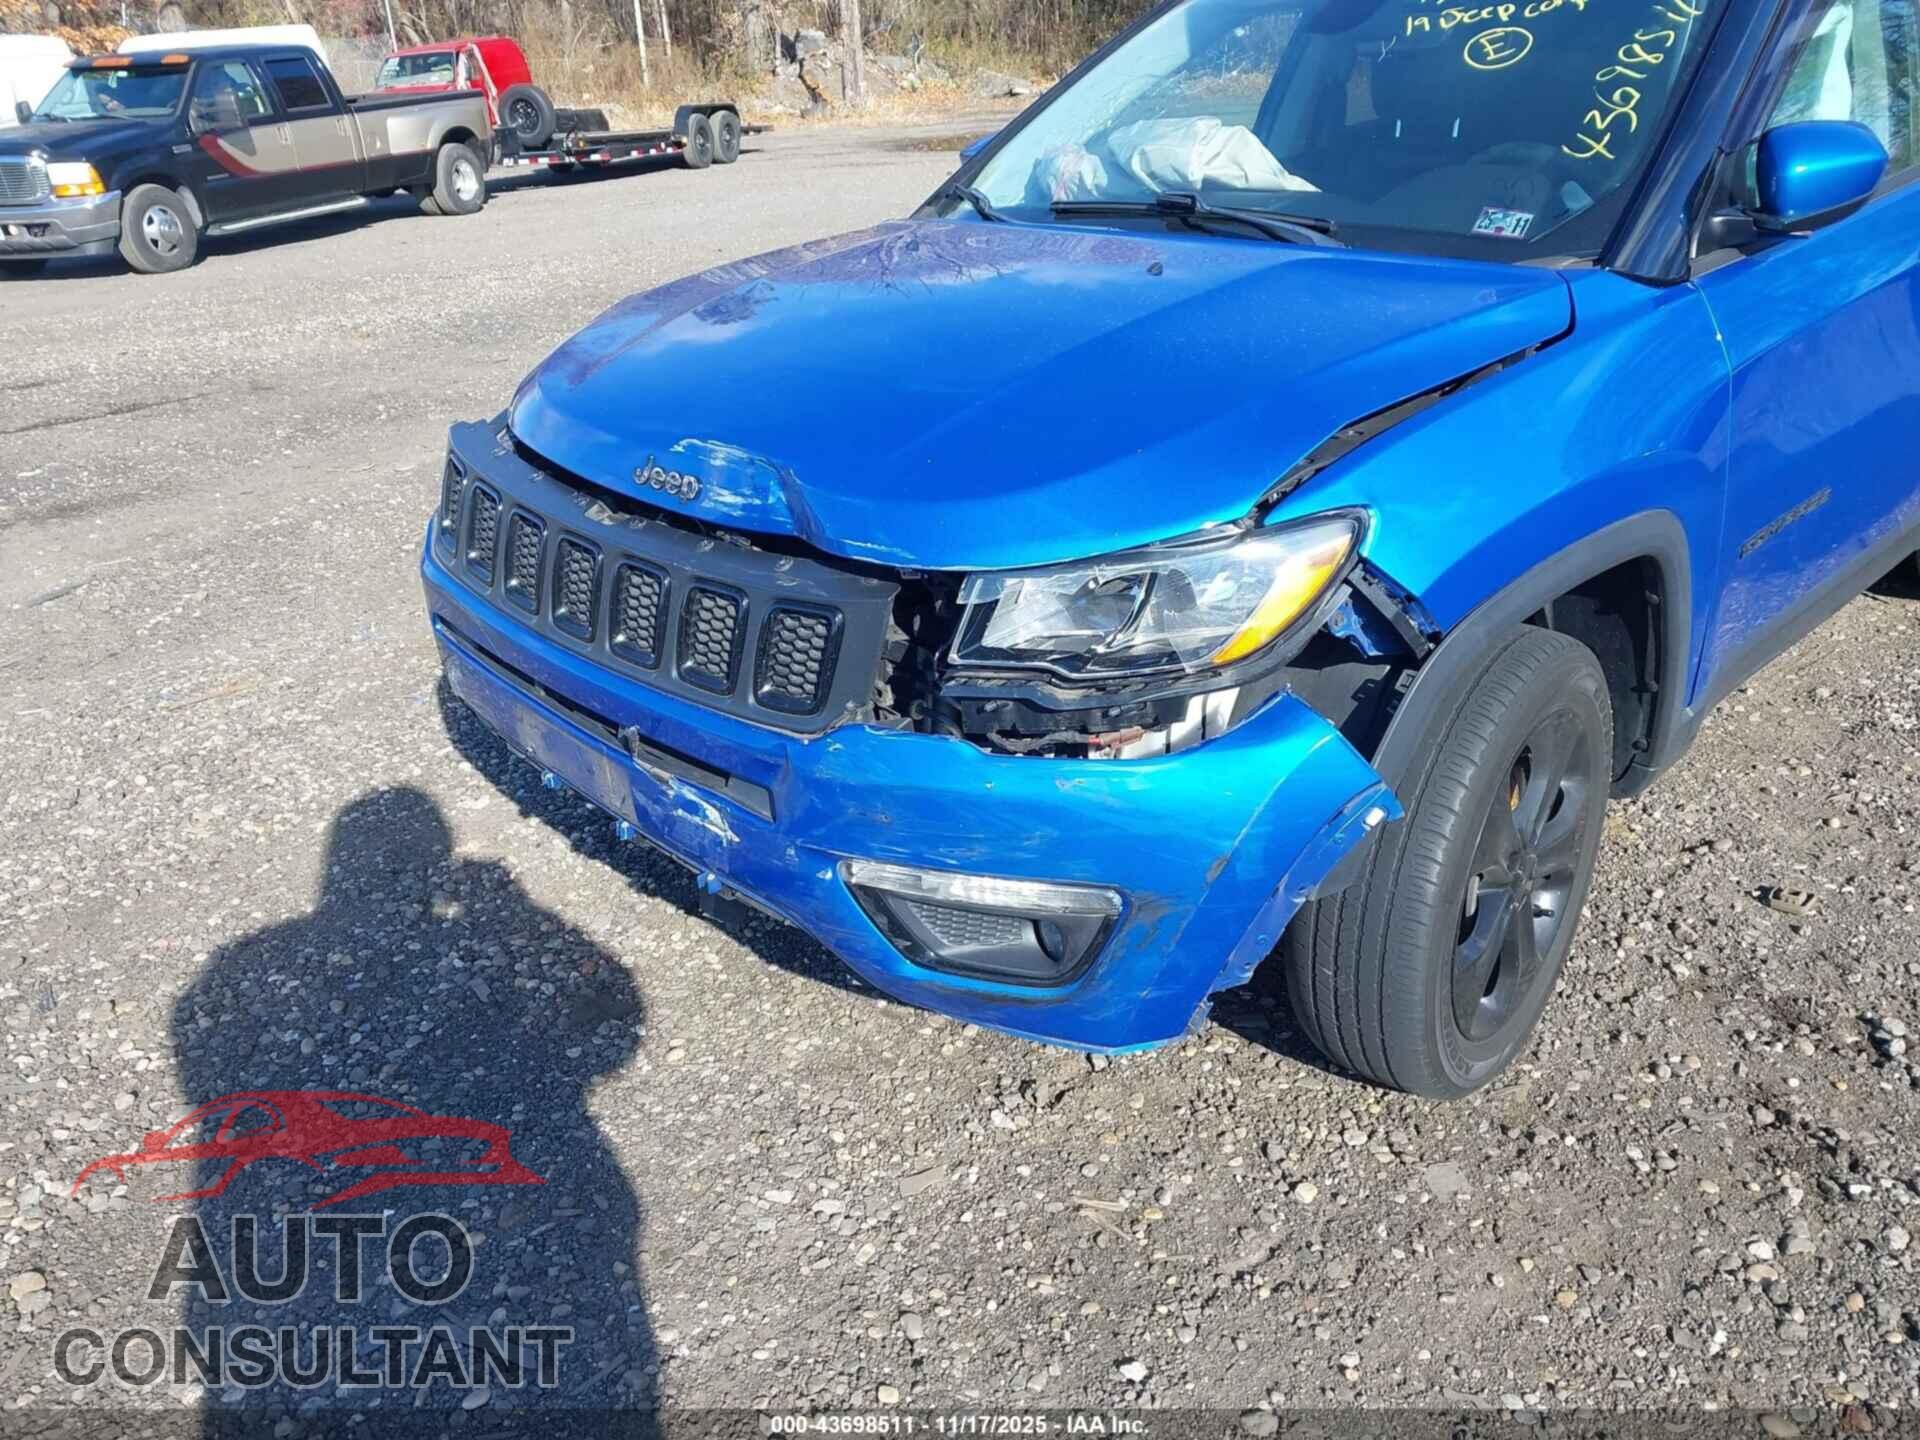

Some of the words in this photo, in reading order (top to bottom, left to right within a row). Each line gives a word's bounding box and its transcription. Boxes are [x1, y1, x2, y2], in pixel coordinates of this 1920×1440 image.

[1406, 15, 1431, 36] 19
[1479, 32, 1516, 60] E
[633, 455, 700, 502] Jeep
